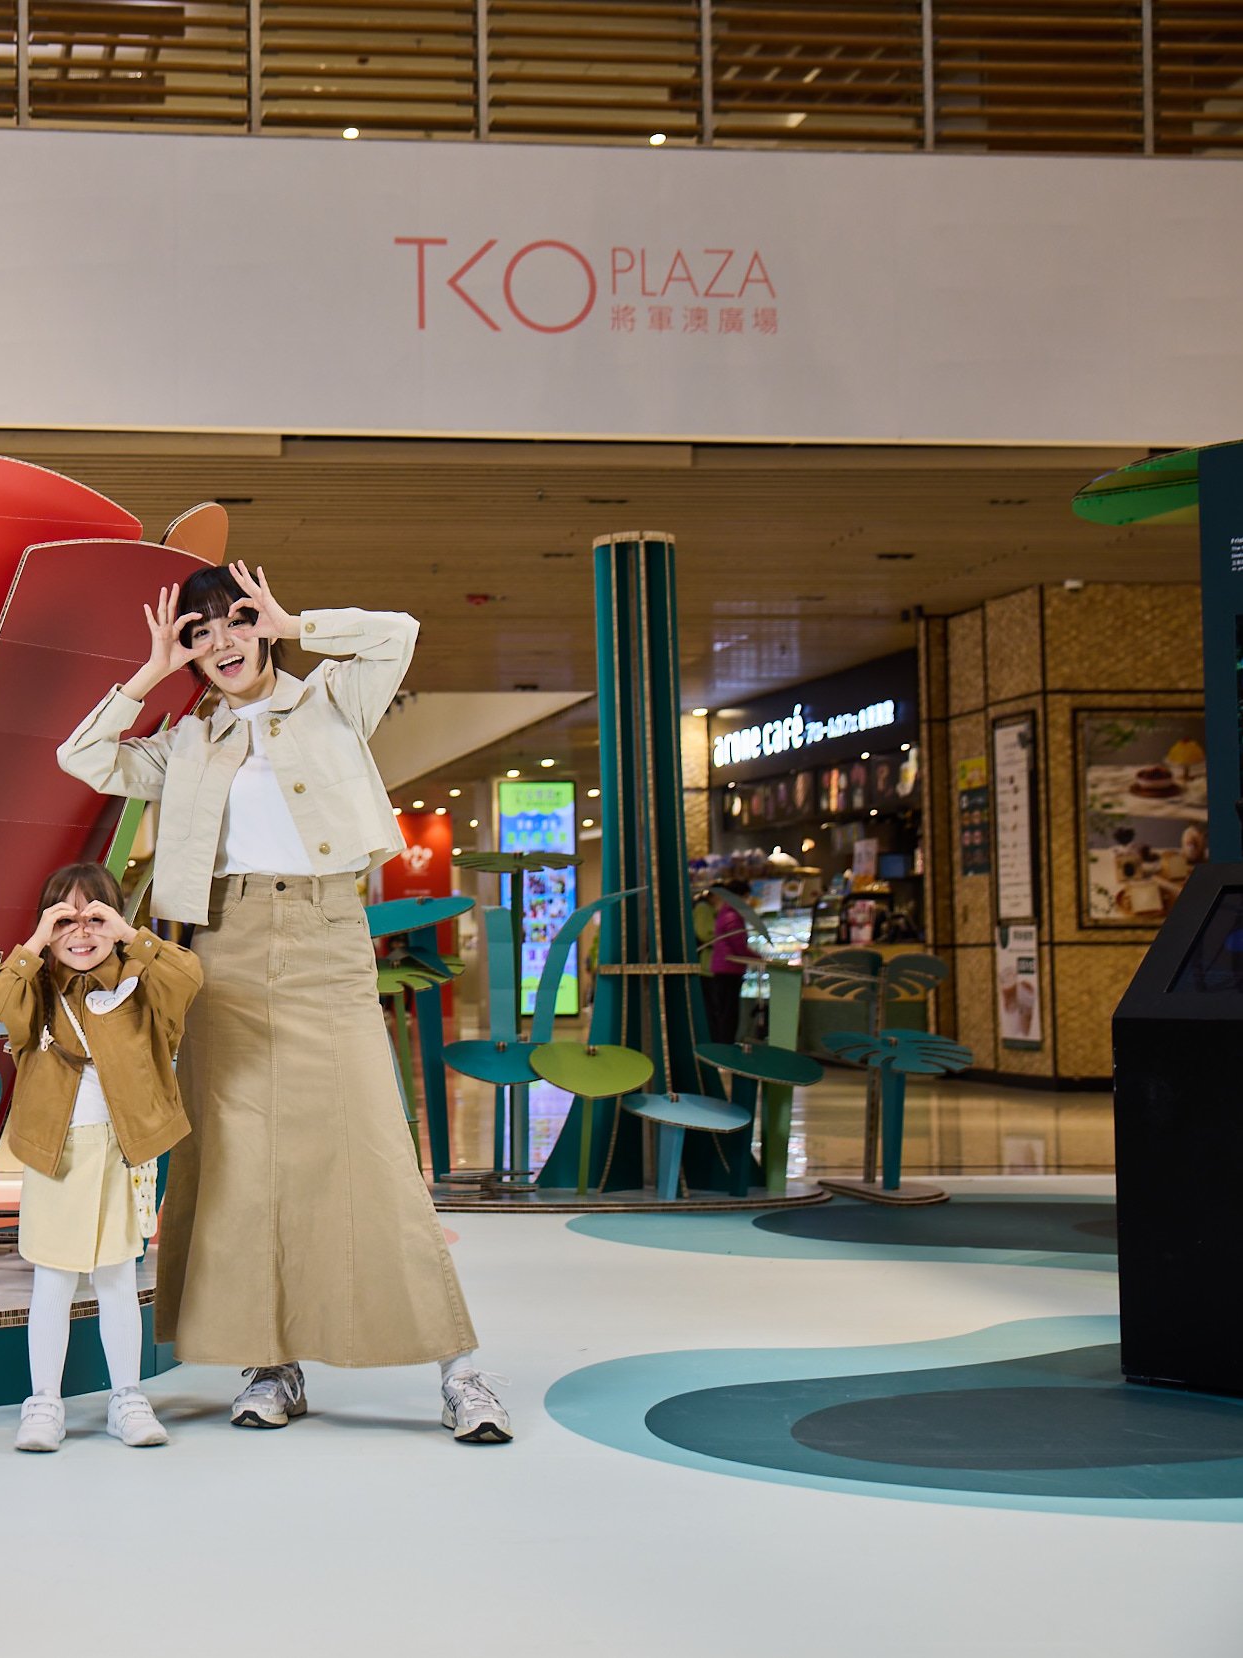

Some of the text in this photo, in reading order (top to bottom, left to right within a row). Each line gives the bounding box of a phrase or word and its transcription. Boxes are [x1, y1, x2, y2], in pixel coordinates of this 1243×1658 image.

[393, 235, 776, 334] TKO PLAZA
[610, 305, 779, 335] 將軍澳廣場
[762, 703, 804, 756] café
